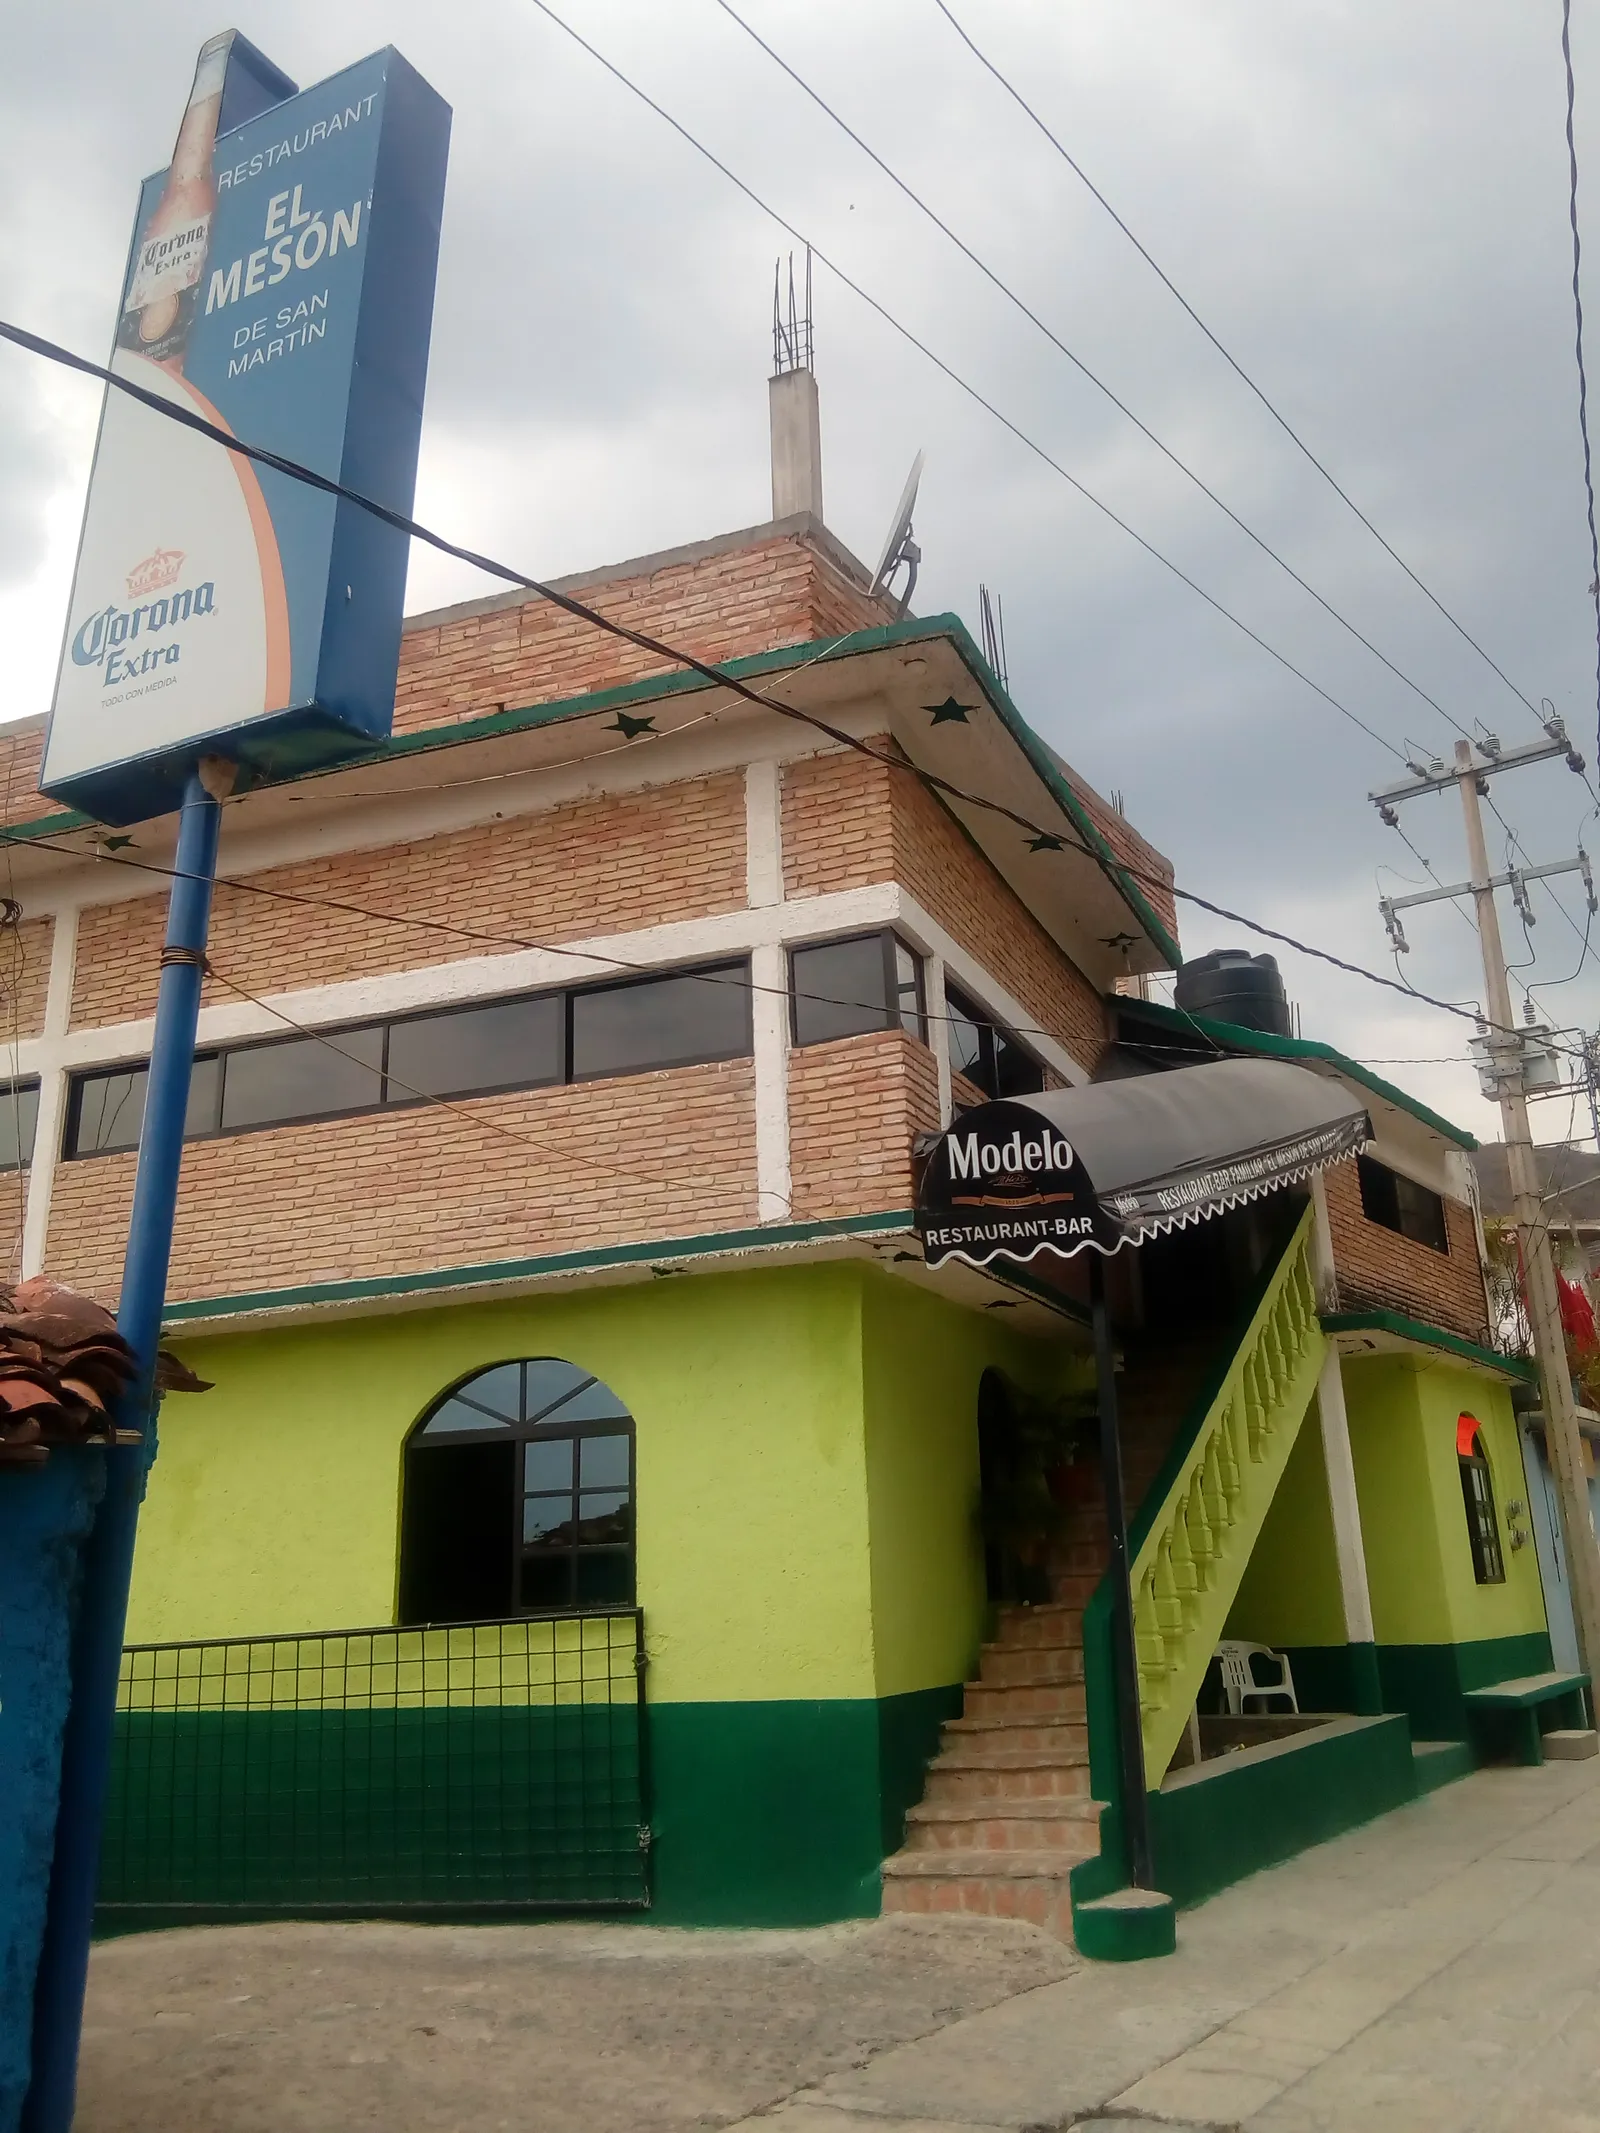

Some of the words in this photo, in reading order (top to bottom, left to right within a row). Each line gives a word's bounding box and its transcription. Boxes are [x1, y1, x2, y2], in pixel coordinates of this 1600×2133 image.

[217, 92, 379, 193] RESTAURANT
[264, 184, 311, 241] EL
[144, 225, 205, 267] Corona
[154, 251, 191, 276] Extra
[204, 200, 361, 316] MESÓN
[233, 317, 269, 349] DE
[275, 288, 329, 329] SAN
[227, 318, 327, 379] MARTÍN
[71, 582, 215, 667] Corona
[101, 694, 124, 709] TODO
[125, 687, 144, 701] CON
[145, 675, 178, 695] MEDIDA
[102, 643, 181, 688] Extra
[946, 1129, 1074, 1180] Modelo
[1156, 1170, 1232, 1212] RESTAURANT-BAR
[1229, 1157, 1266, 1185] FAMILIAR
[1298, 1141, 1309, 1160] DE
[926, 1217, 1094, 1247] RESTAURANT-BAR
